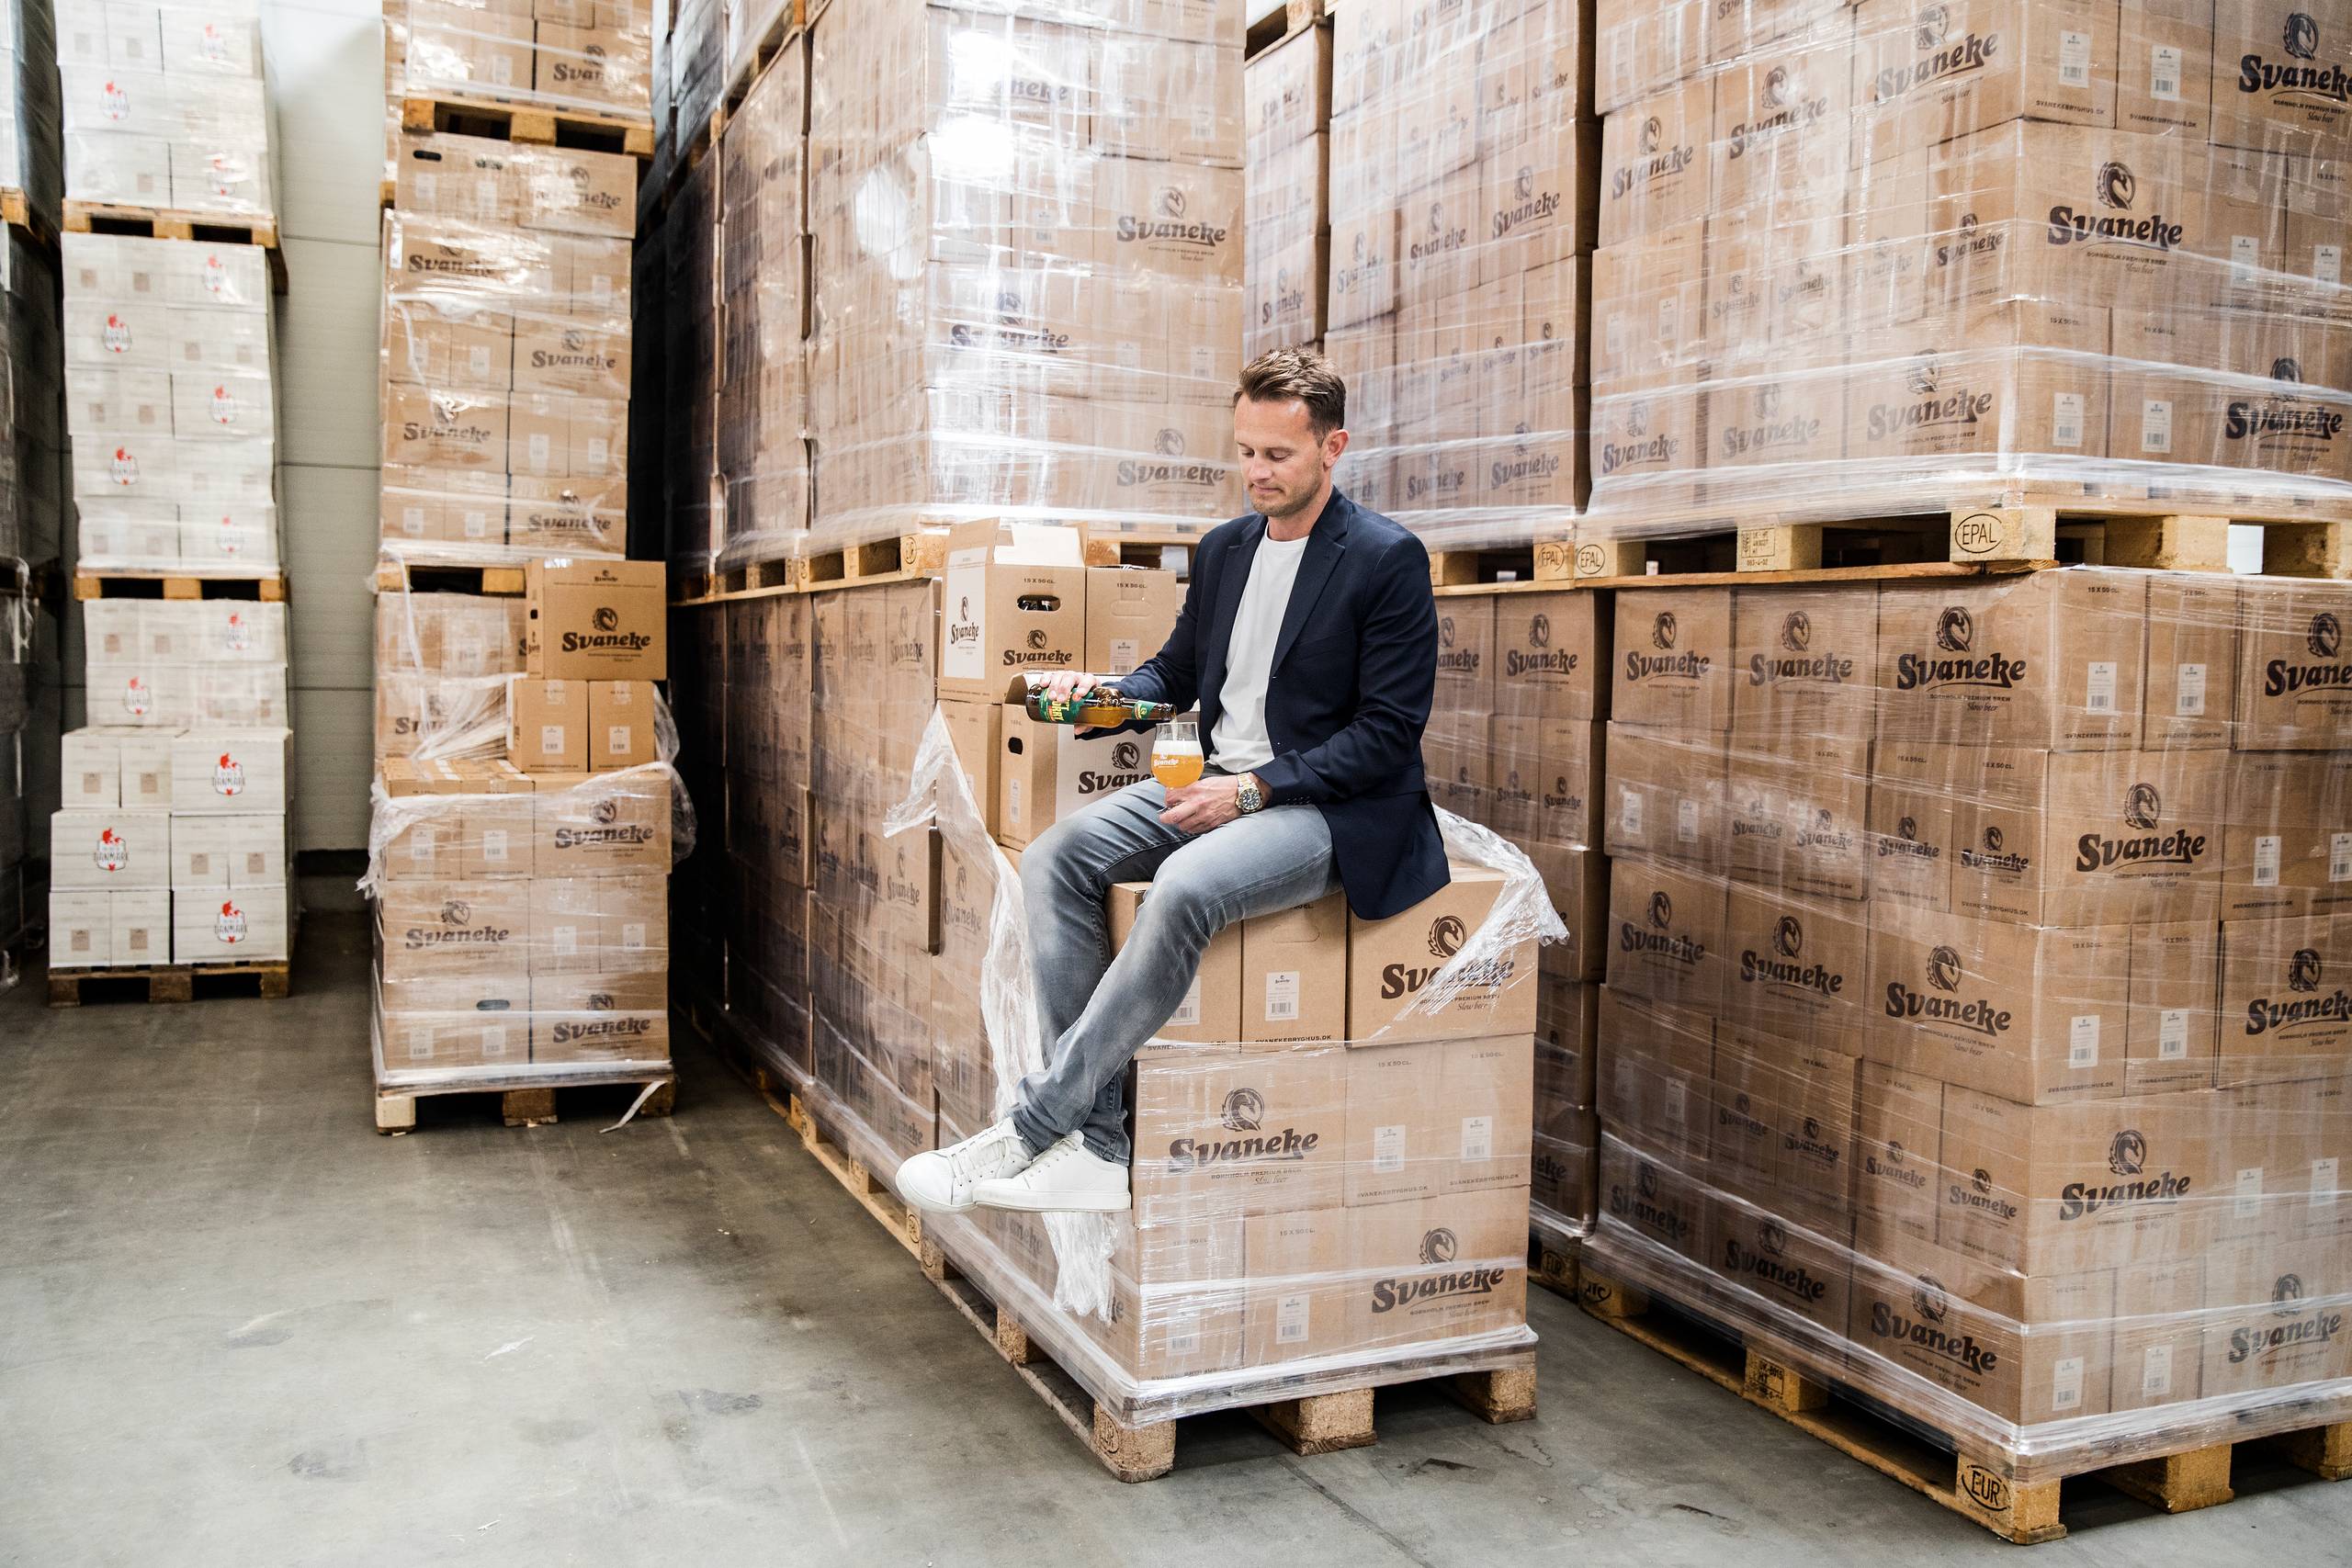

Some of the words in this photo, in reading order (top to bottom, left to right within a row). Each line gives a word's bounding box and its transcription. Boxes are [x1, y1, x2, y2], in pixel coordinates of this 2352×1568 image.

[1874, 31, 1998, 107] Svaneke
[1729, 96, 1827, 159] Svaneke
[1612, 145, 1694, 200] Svaneke
[1116, 216, 1227, 246] Svaneke
[1492, 191, 1560, 240] Svaneke
[2048, 205, 2183, 252] Svaneke
[1937, 231, 2004, 267] Svaneke
[532, 350, 616, 370] Svaneke
[1866, 388, 1992, 442] Svaneke
[2225, 401, 2343, 440] Svaneke
[1722, 414, 1820, 457] Svaneke
[1491, 453, 1559, 490] Svaneke
[1601, 433, 1680, 475] Svaneke
[1116, 460, 1227, 487] Svaneke
[528, 513, 611, 533] Svaneke
[1962, 524, 1997, 546] EPAL
[1579, 551, 1602, 569] EPAL
[561, 631, 651, 652] Svaneke
[951, 622, 979, 645] Svaneke
[1003, 649, 1073, 666] Svaneke
[1437, 648, 1480, 672] aneke
[1507, 649, 1578, 677] Svaneke
[1626, 650, 1711, 682] Svaneke
[1749, 652, 1853, 688] Svaneke
[1897, 652, 2027, 691] Svaneke
[1051, 700, 1065, 721] ORRY
[1967, 701, 1984, 712] Slow
[1984, 702, 1999, 712] beer
[1079, 771, 1154, 794] Svane
[1544, 794, 1581, 810] Svaneke
[555, 825, 653, 849] Svaneke
[1796, 829, 1853, 850] Svaneke
[1878, 839, 1939, 861] Svaneke
[2075, 829, 2206, 873] Svaneke
[1961, 849, 2030, 873] Svaneke
[405, 926, 509, 949] Svaneke
[1620, 921, 1705, 966] Svaneke
[1740, 949, 1843, 998] Svaneke
[1457, 1002, 1473, 1011] Slow
[1474, 1000, 1488, 1010] beer
[1885, 982, 2011, 1037] Svaneke
[553, 1017, 650, 1043] Svaneke
[1168, 1128, 1318, 1174] Svaneke
[1784, 1135, 1840, 1162] Svaneke
[1866, 1156, 1927, 1189] Svaneke
[1611, 1185, 1688, 1240] Svaneke
[1950, 1185, 2018, 1221] Svaneke
[2060, 1170, 2192, 1221] Svaneke
[1724, 1239, 1826, 1303] Svaneke
[1372, 1265, 1505, 1314] Svaneke
[1871, 1301, 1998, 1375] Svaneke
[2228, 1311, 2342, 1364] Svaneke
[1971, 1470, 2000, 1506] EUR
